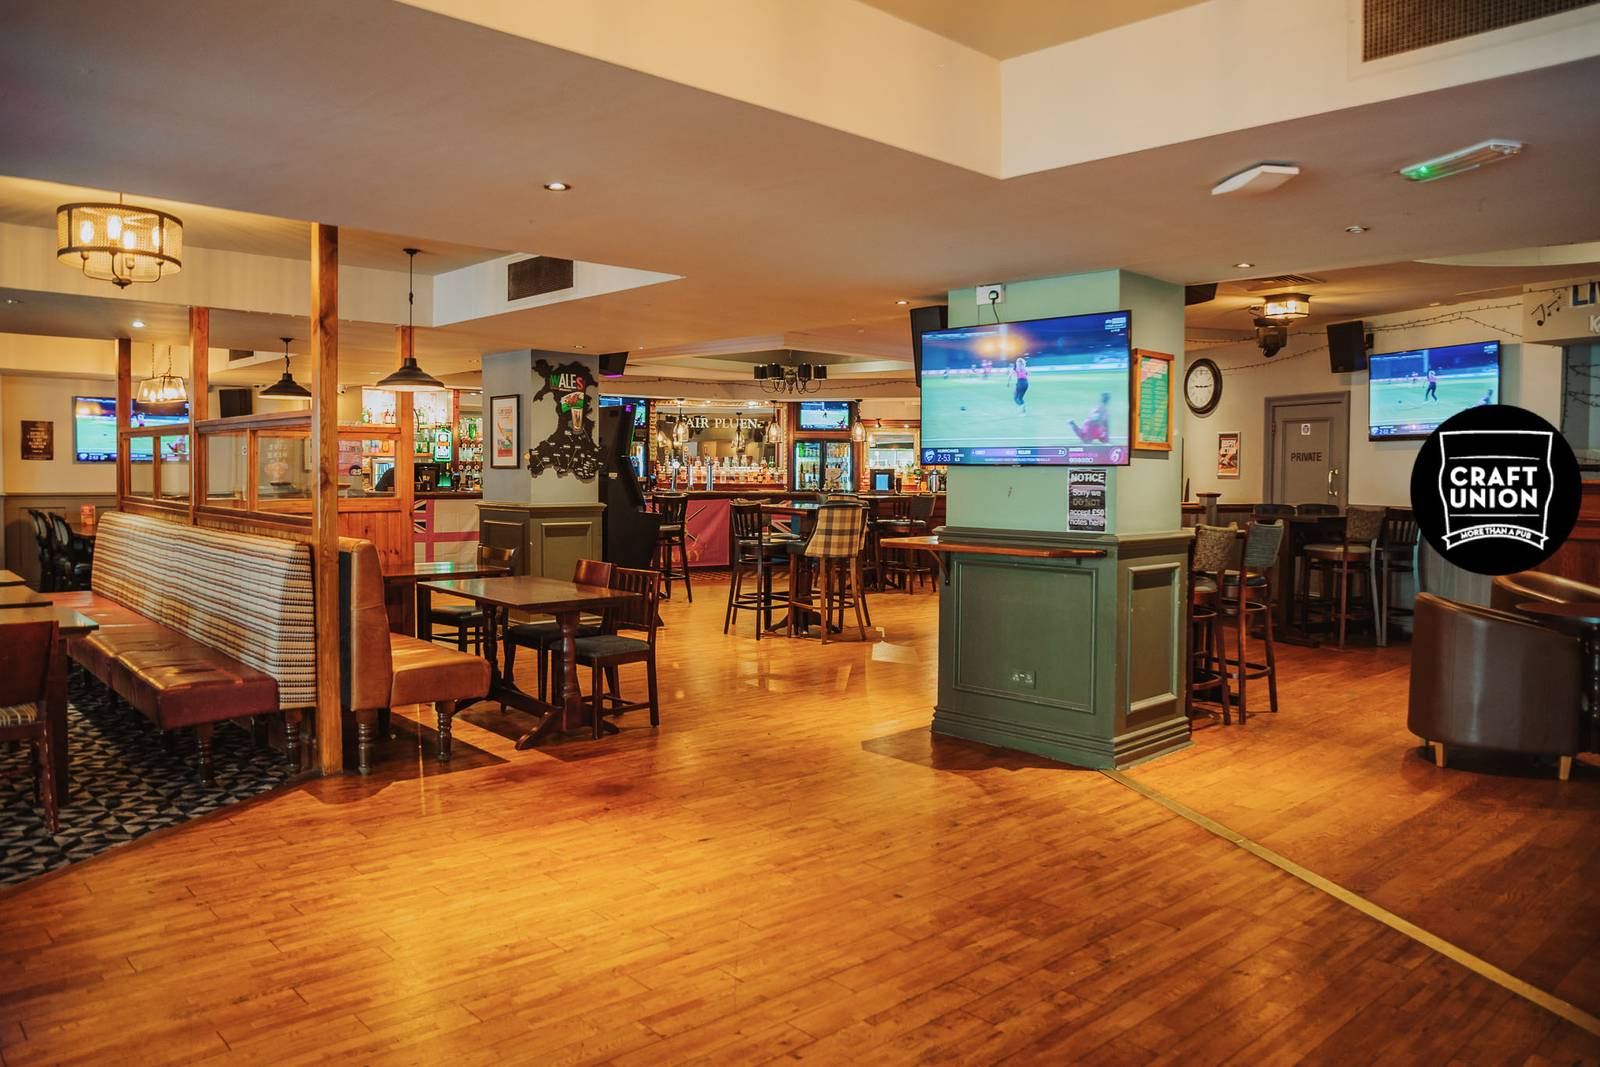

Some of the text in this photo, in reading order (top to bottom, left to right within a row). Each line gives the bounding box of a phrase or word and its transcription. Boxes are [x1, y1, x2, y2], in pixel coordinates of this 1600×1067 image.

[1571, 281, 1600, 306] LI
[550, 373, 584, 390] WALES
[677, 417, 709, 429] AIR
[937, 454, 951, 462] 2-53
[1290, 452, 1322, 462] PRIVATE
[1071, 473, 1105, 482] NOTICE
[1073, 489, 1089, 498] Sorry
